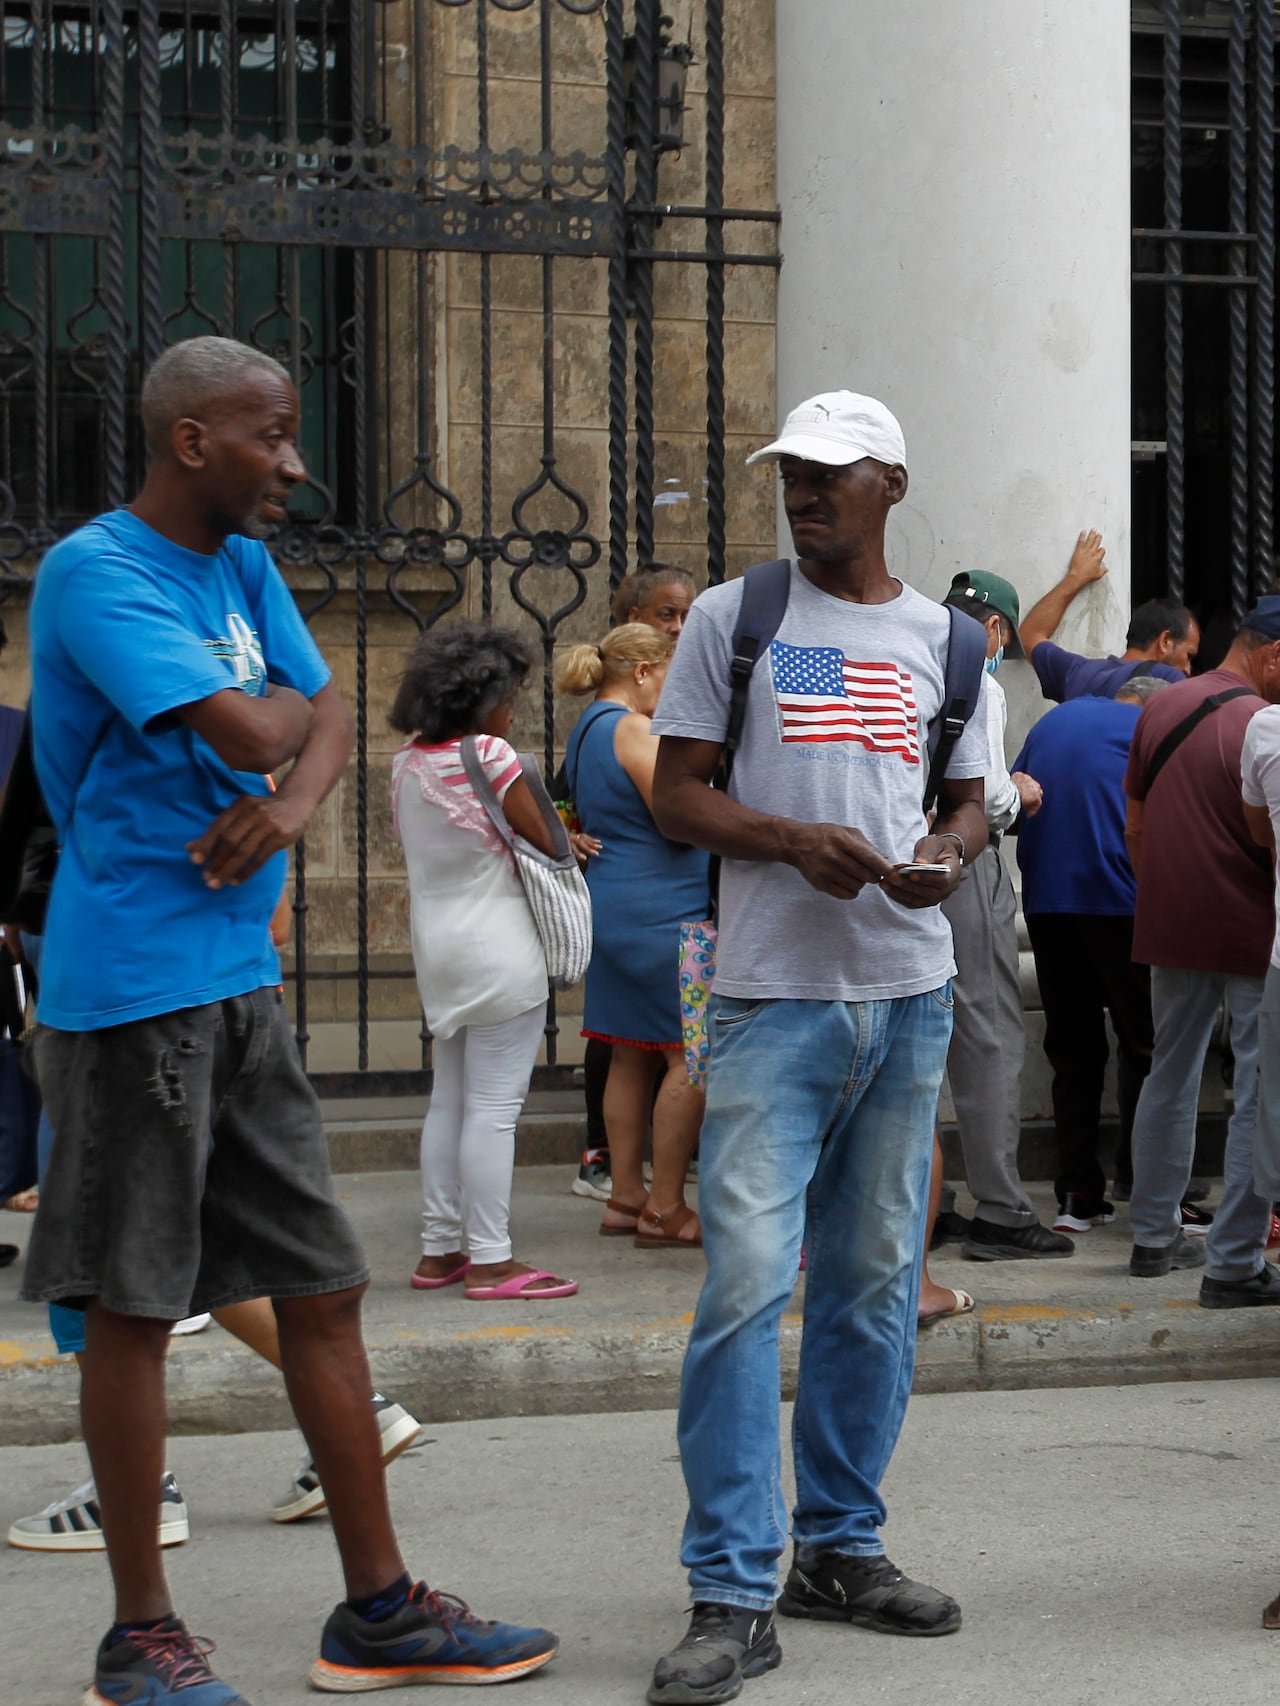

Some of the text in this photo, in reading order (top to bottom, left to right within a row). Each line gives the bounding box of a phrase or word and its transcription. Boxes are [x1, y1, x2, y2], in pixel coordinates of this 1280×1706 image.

[796, 749, 825, 761] MADE
[827, 751, 837, 761] IN
[840, 753, 881, 767] AMERICA
